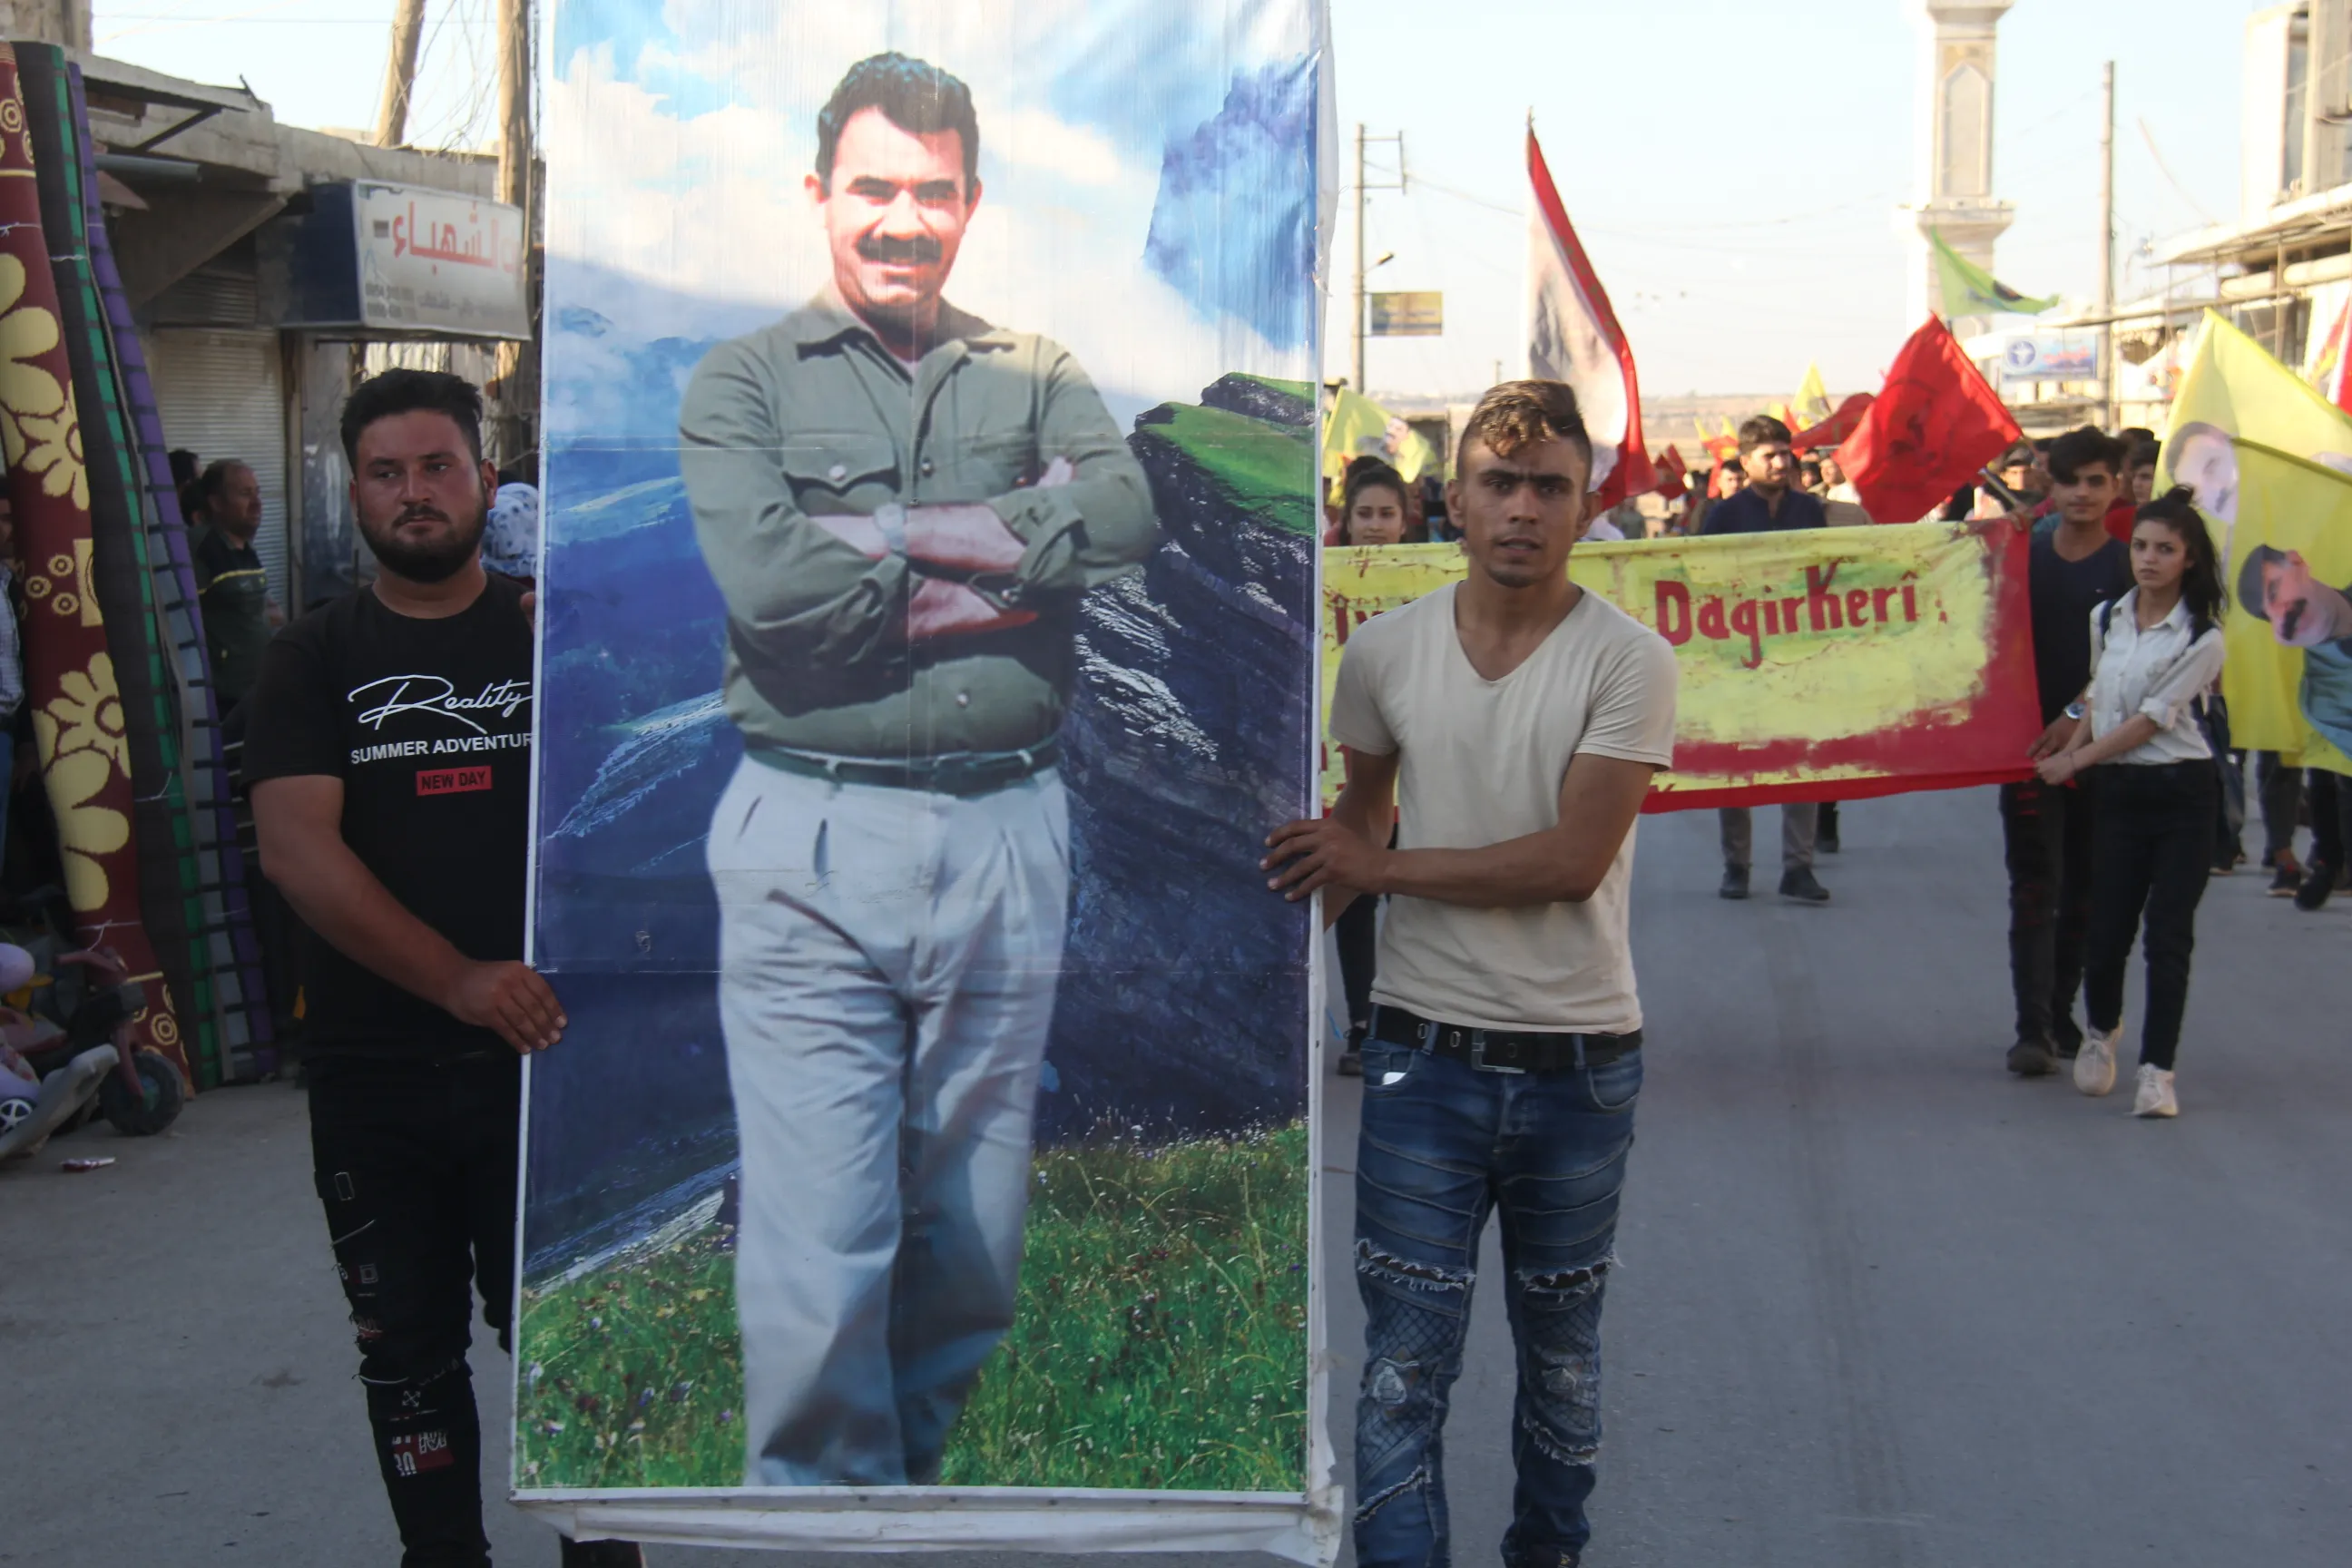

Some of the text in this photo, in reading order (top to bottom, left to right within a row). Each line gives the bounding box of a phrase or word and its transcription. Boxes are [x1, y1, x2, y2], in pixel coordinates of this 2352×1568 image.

[348, 674, 534, 735] Reality
[350, 740, 429, 764] SUMMER
[421, 770, 486, 790] NEW DAY
